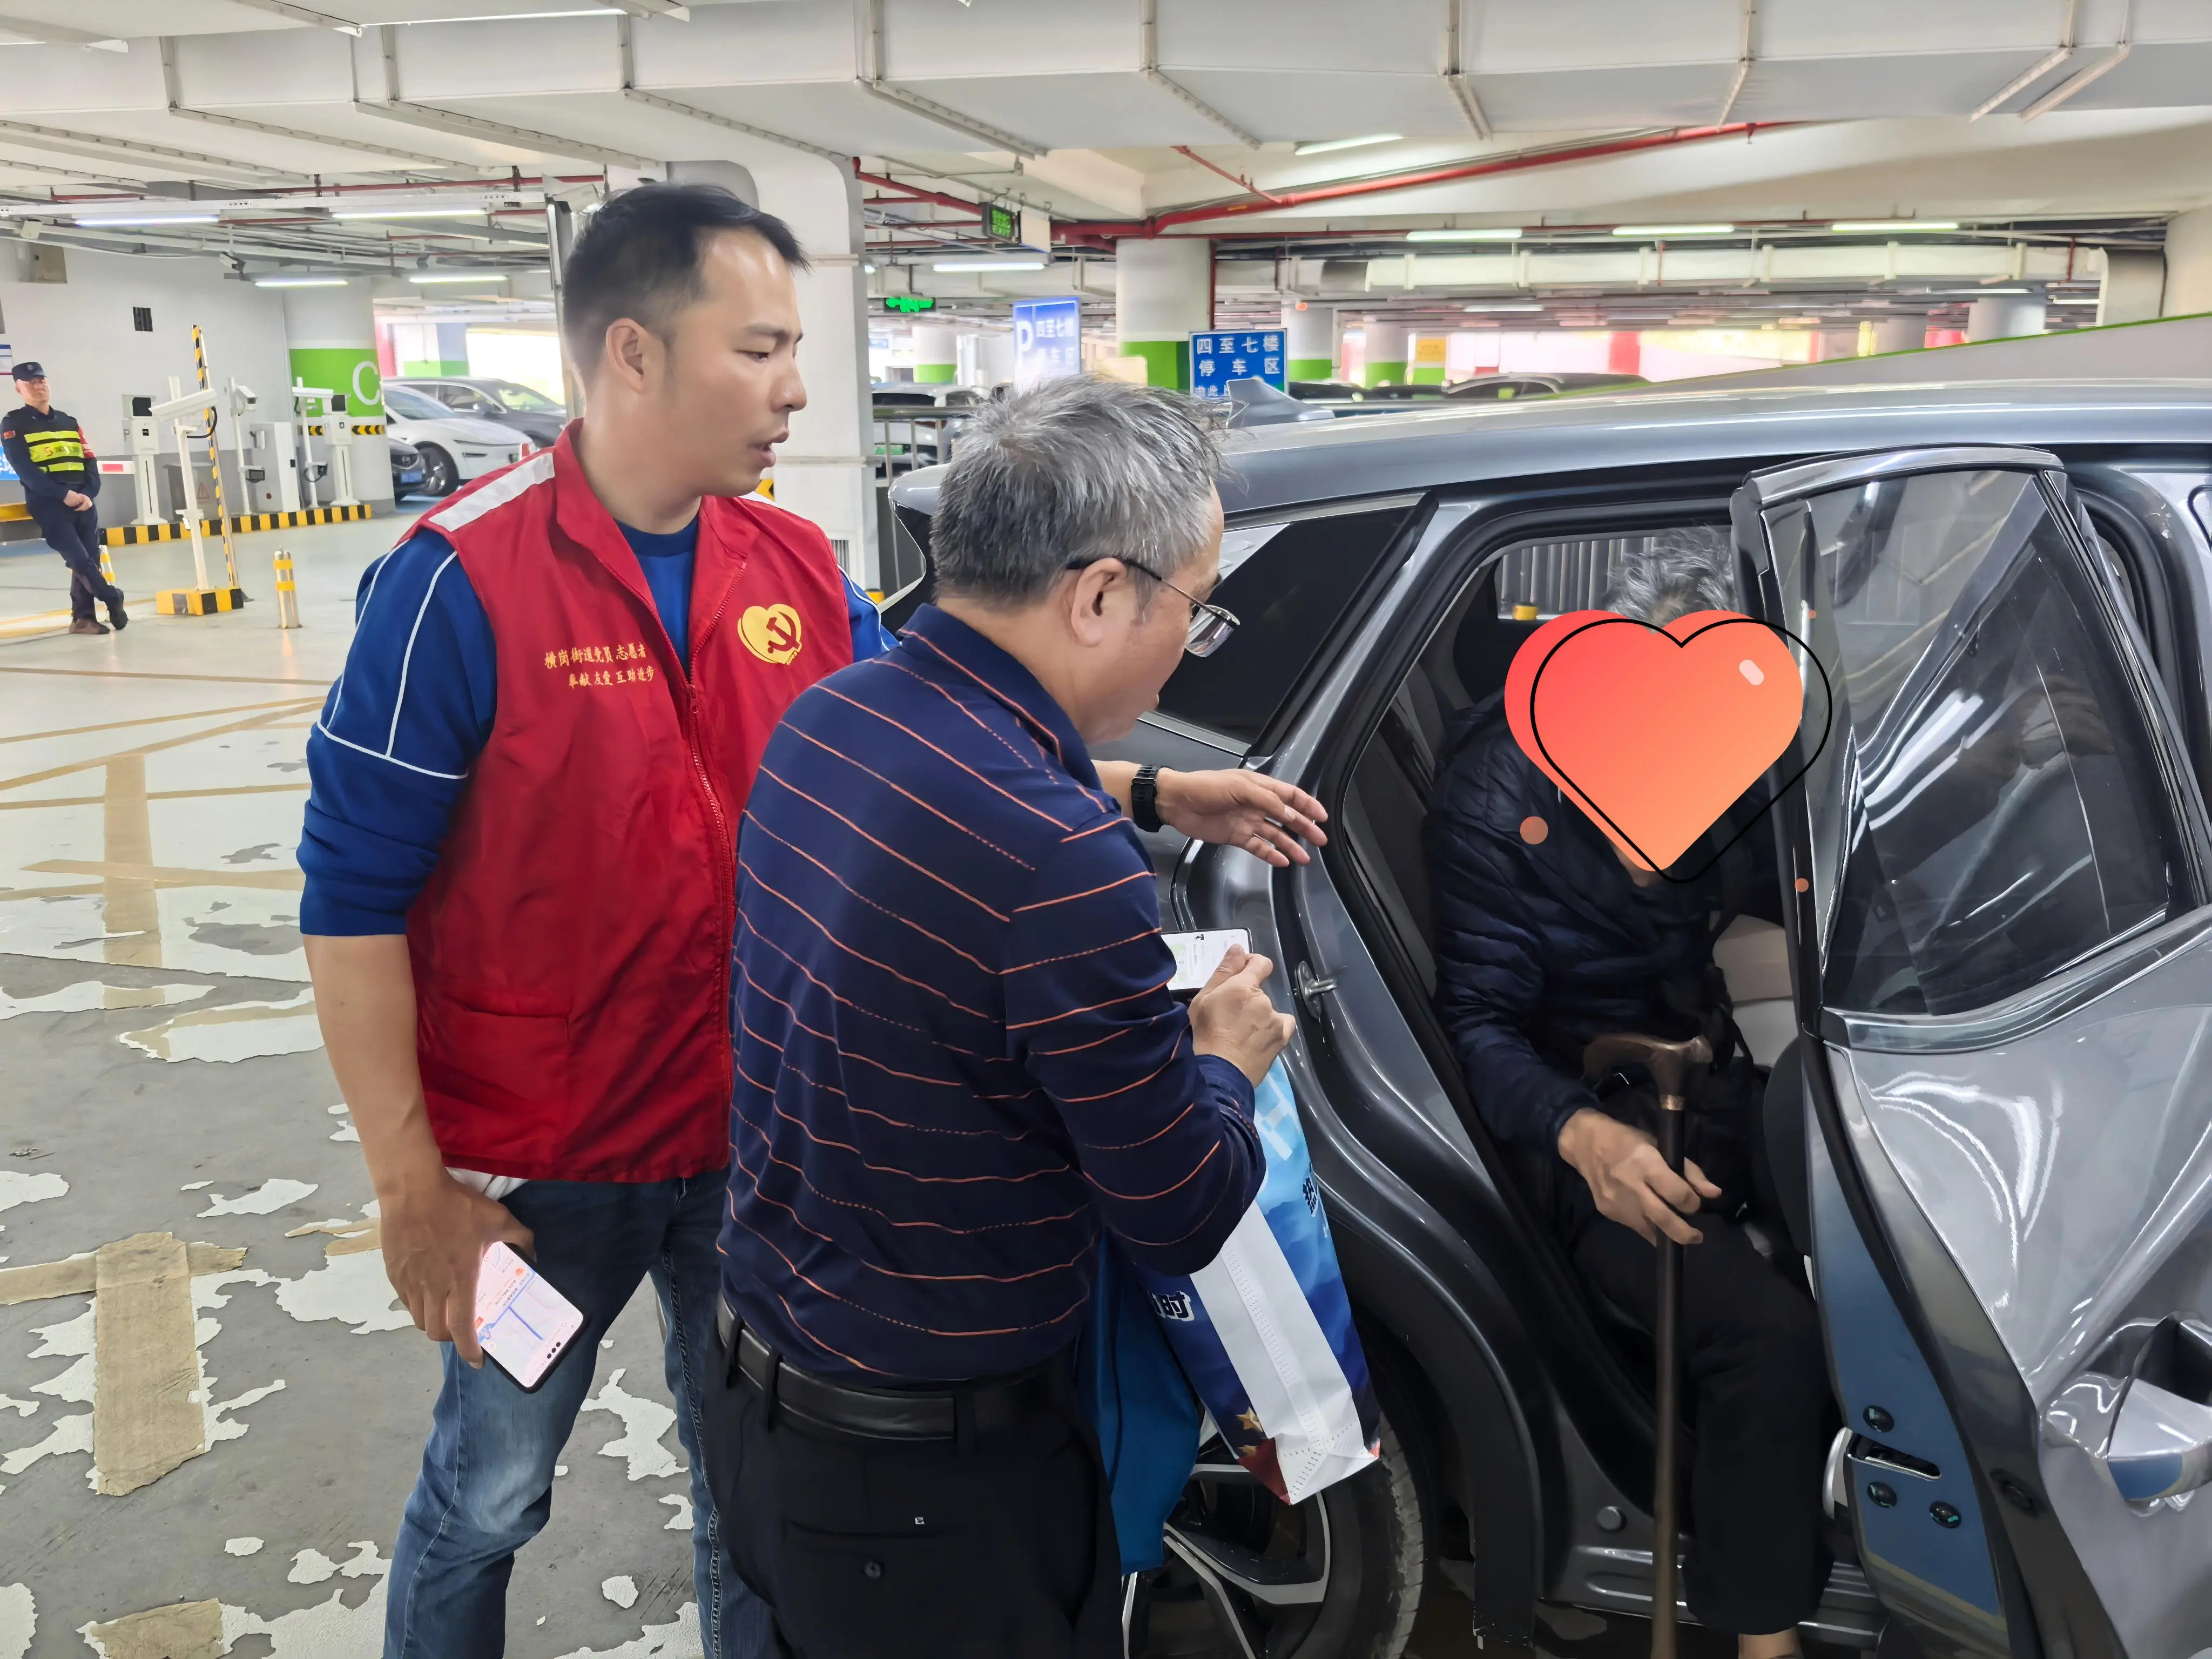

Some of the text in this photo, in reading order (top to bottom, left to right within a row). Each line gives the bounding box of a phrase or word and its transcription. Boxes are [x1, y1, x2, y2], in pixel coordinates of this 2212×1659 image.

[1016, 321, 1033, 368] P
[1197, 335, 1279, 354] 四至七楼
[1199, 358, 1280, 376] 停车区
[353, 361, 381, 405] C
